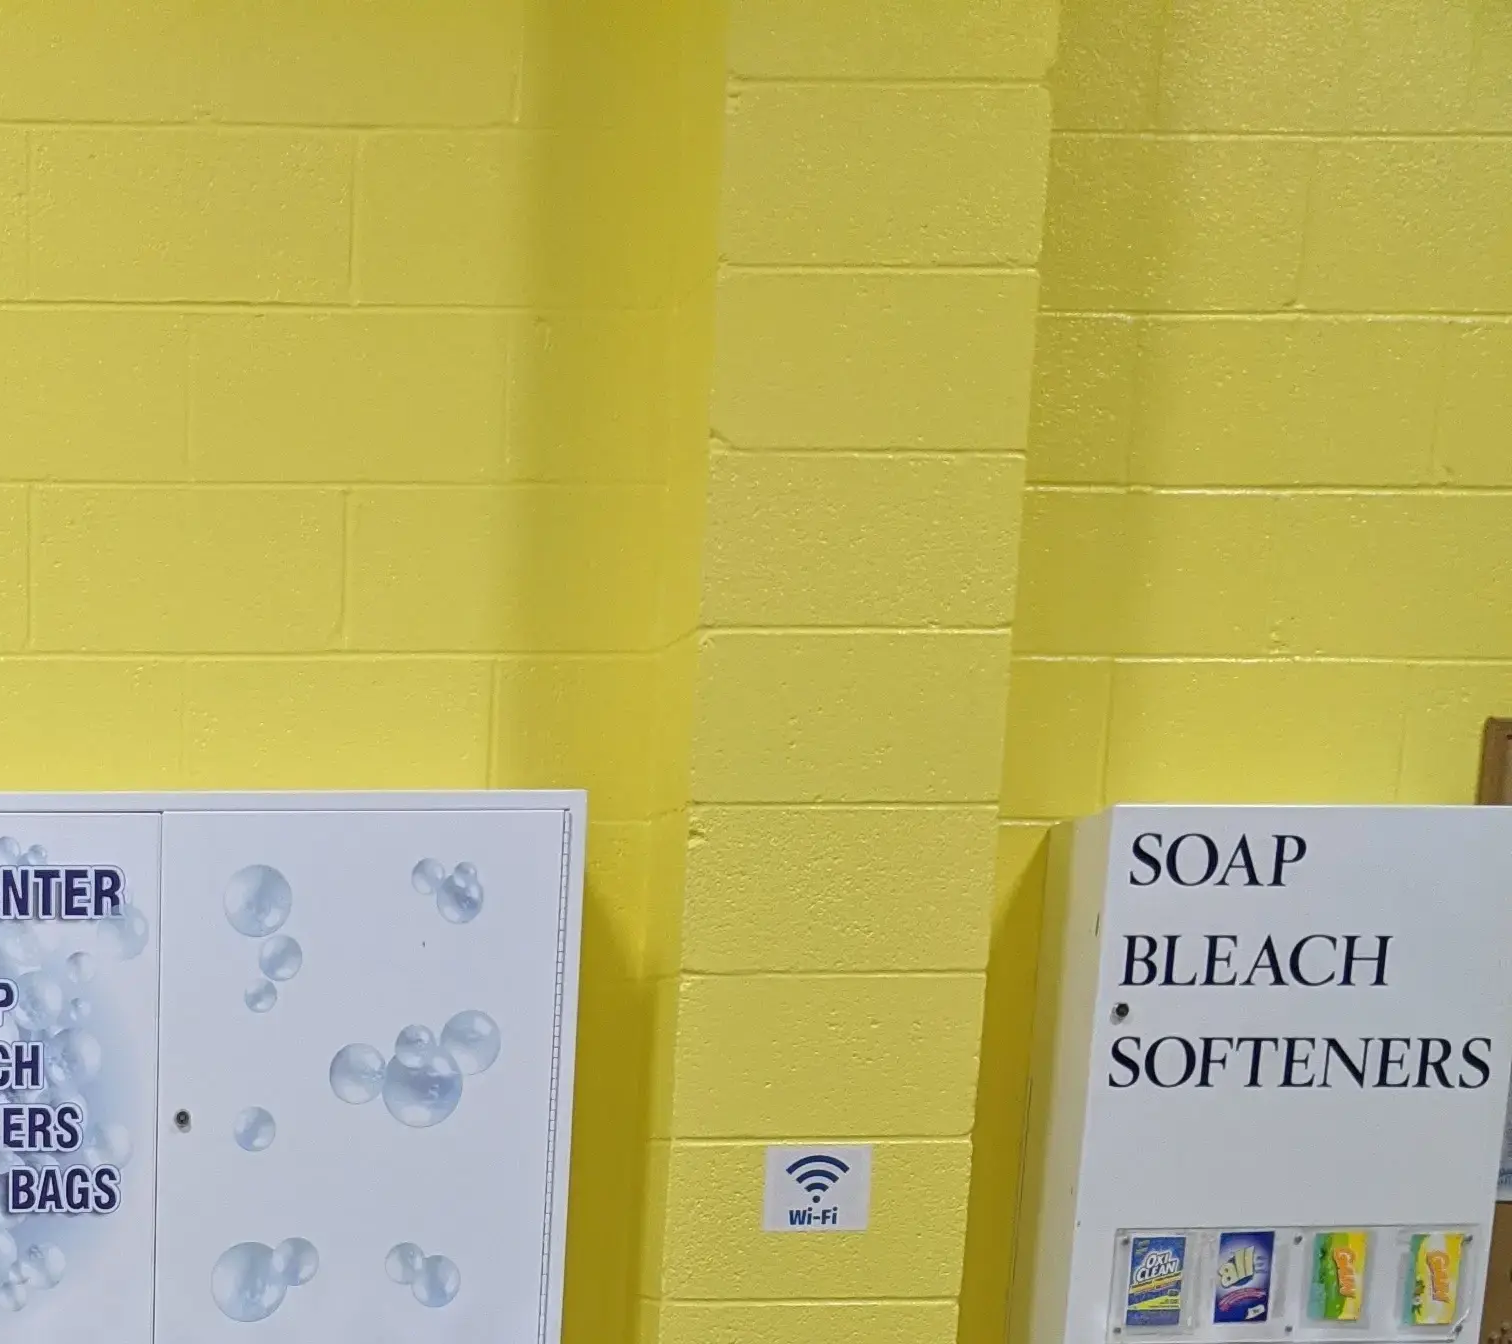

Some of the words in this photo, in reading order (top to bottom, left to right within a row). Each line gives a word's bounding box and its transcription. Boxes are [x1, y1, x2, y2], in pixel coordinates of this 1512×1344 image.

[1129, 833, 1307, 887] SOAP
[1118, 935, 1393, 987] BLEACH
[1108, 1036, 1492, 1089] SOFTENERS
[10, 1167, 119, 1211] BAGS
[789, 1206, 838, 1225] Wi-Fi
[1137, 1261, 1176, 1281] CLEAN
[1146, 1253, 1170, 1268] OXI
